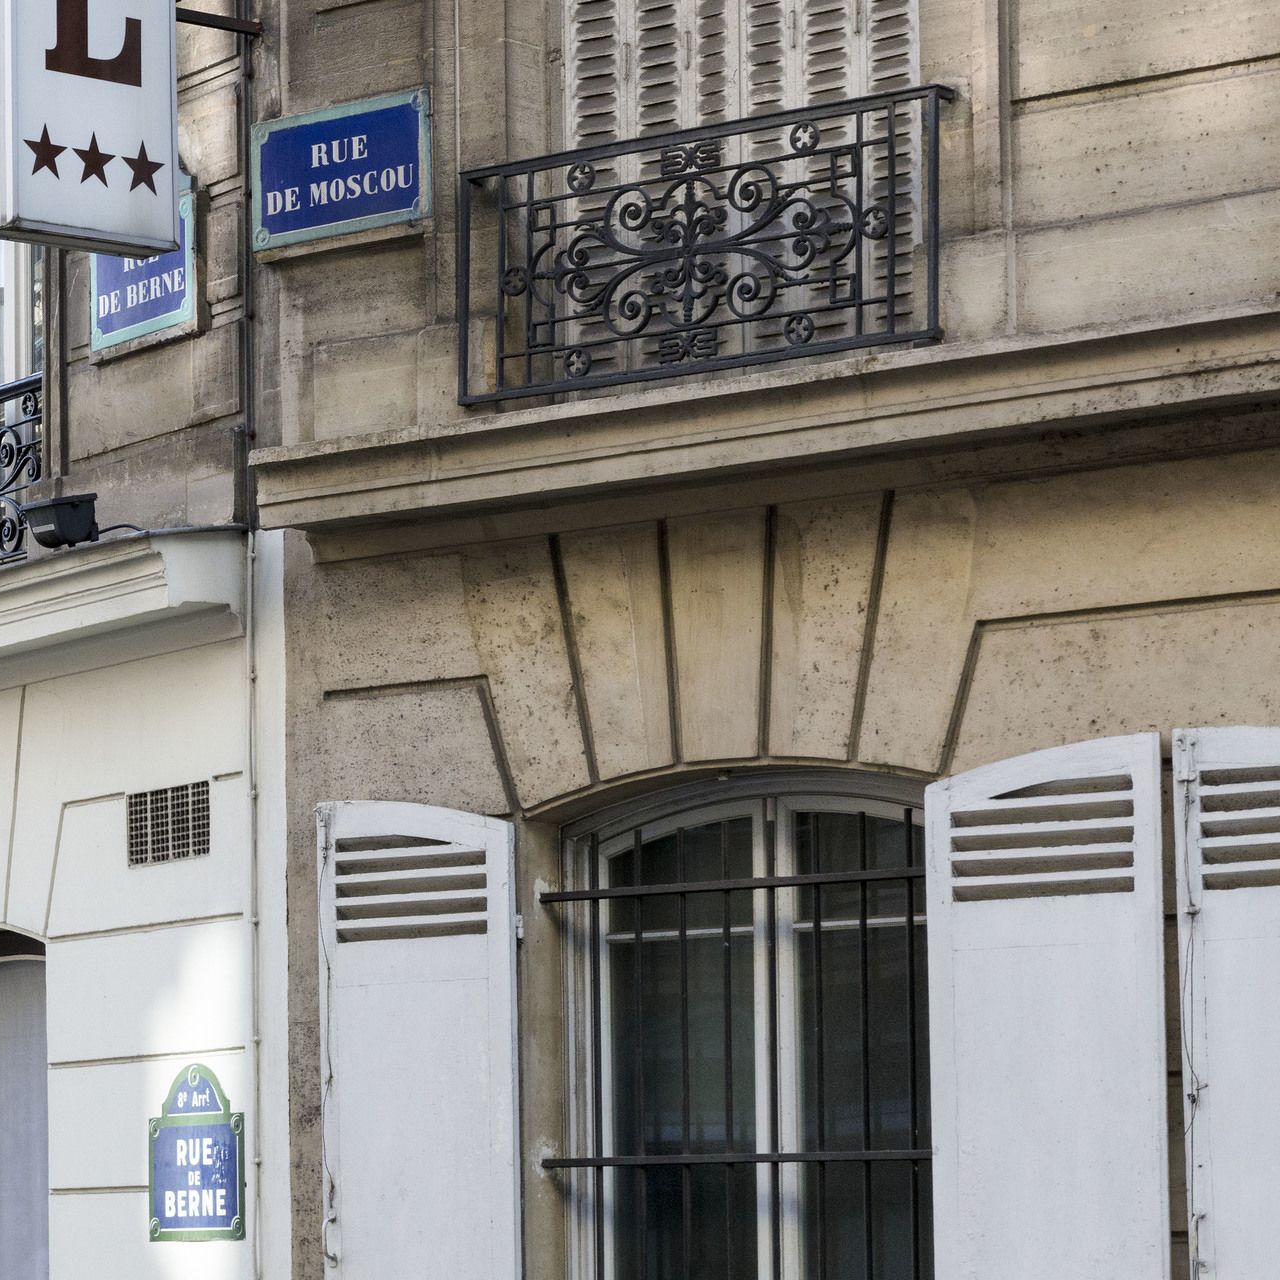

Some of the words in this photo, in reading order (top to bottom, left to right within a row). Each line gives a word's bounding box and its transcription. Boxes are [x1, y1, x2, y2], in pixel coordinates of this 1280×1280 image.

[311, 134, 368, 168] RUE
[266, 187, 301, 216] DE
[309, 163, 414, 208] MOSCOU
[98, 290, 121, 318] DE
[126, 267, 185, 308] BERNE
[176, 1138, 214, 1166] RUE
[188, 1171, 201, 1186] DE
[165, 1189, 227, 1217] BERNE
